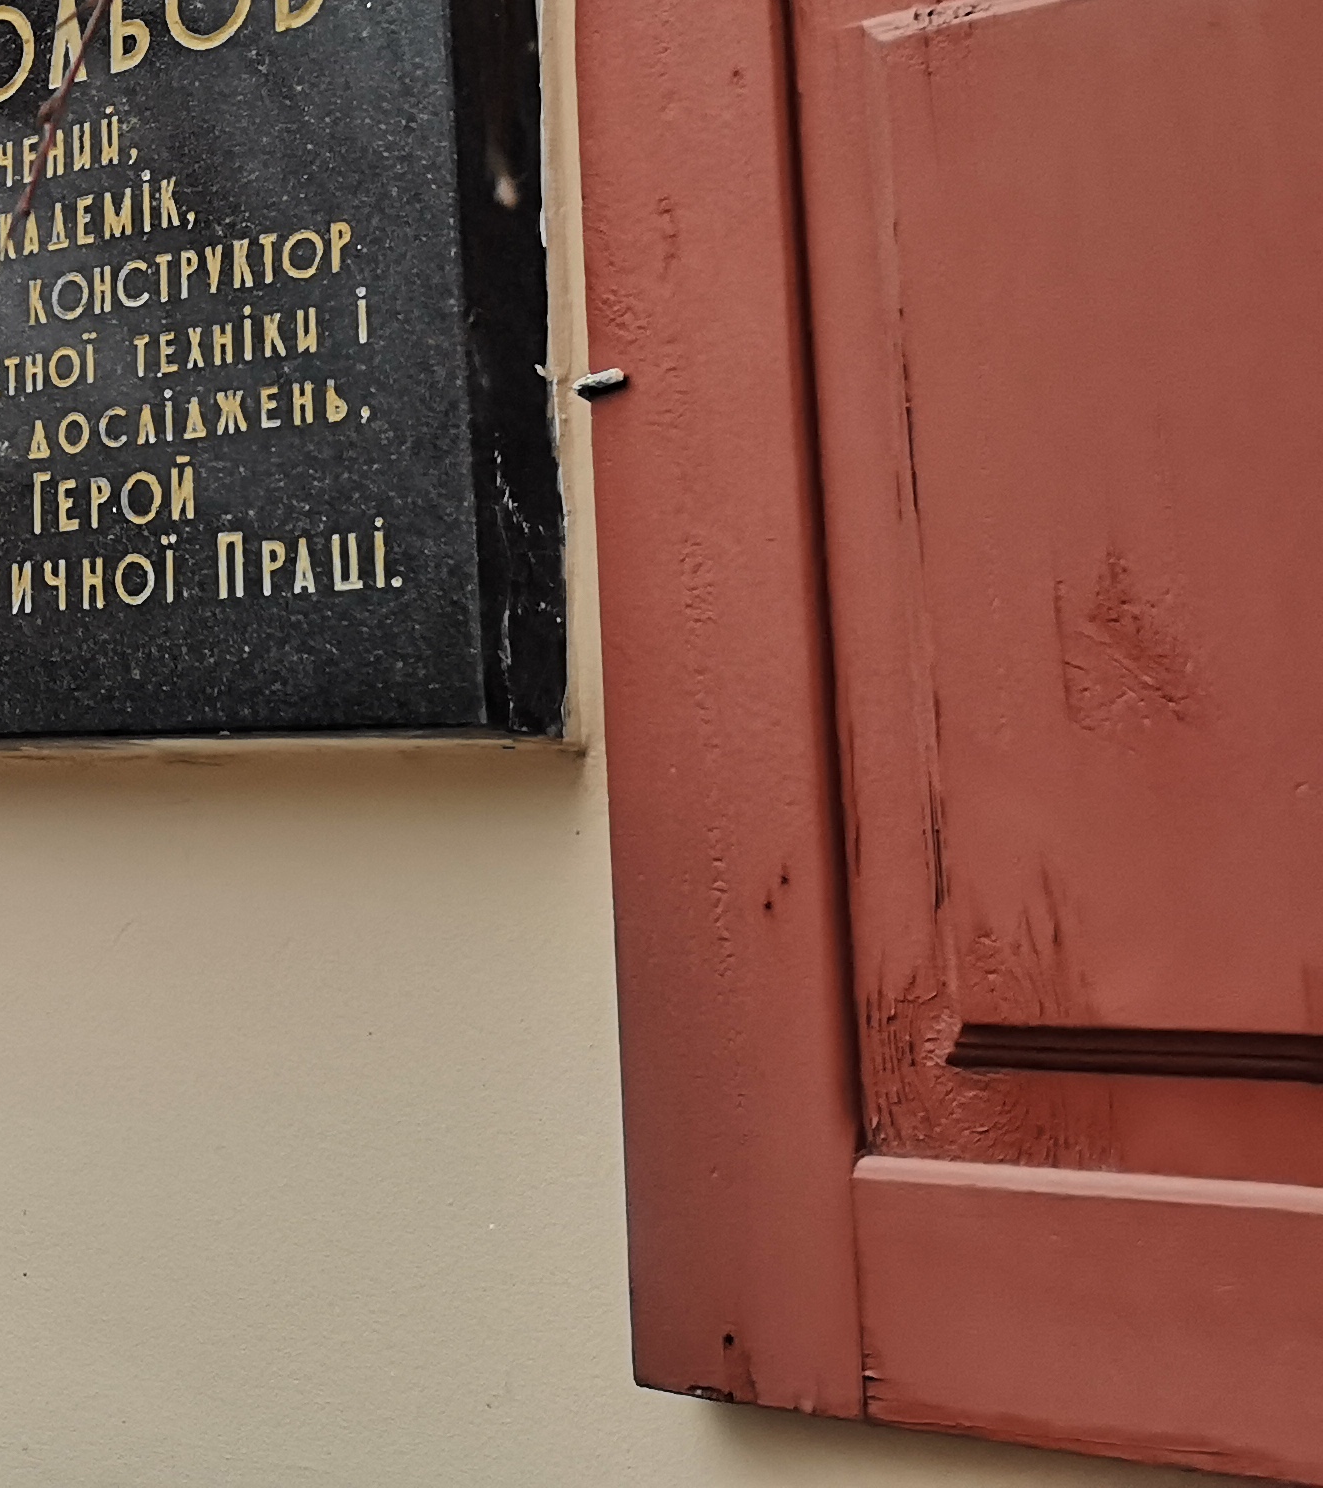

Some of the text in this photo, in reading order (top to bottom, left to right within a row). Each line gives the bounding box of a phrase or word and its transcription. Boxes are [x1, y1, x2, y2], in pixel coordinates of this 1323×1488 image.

[26, 221, 352, 326] КОНСТРУКТОР
[133, 305, 318, 377] ТЕХНІКИ
[356, 287, 368, 345] І
[27, 378, 370, 460] ДОСЛІДЖЕНЬ,
[33, 455, 195, 534] ГЕРОЙ
[217, 516, 402, 599] ПРАЦІ.
